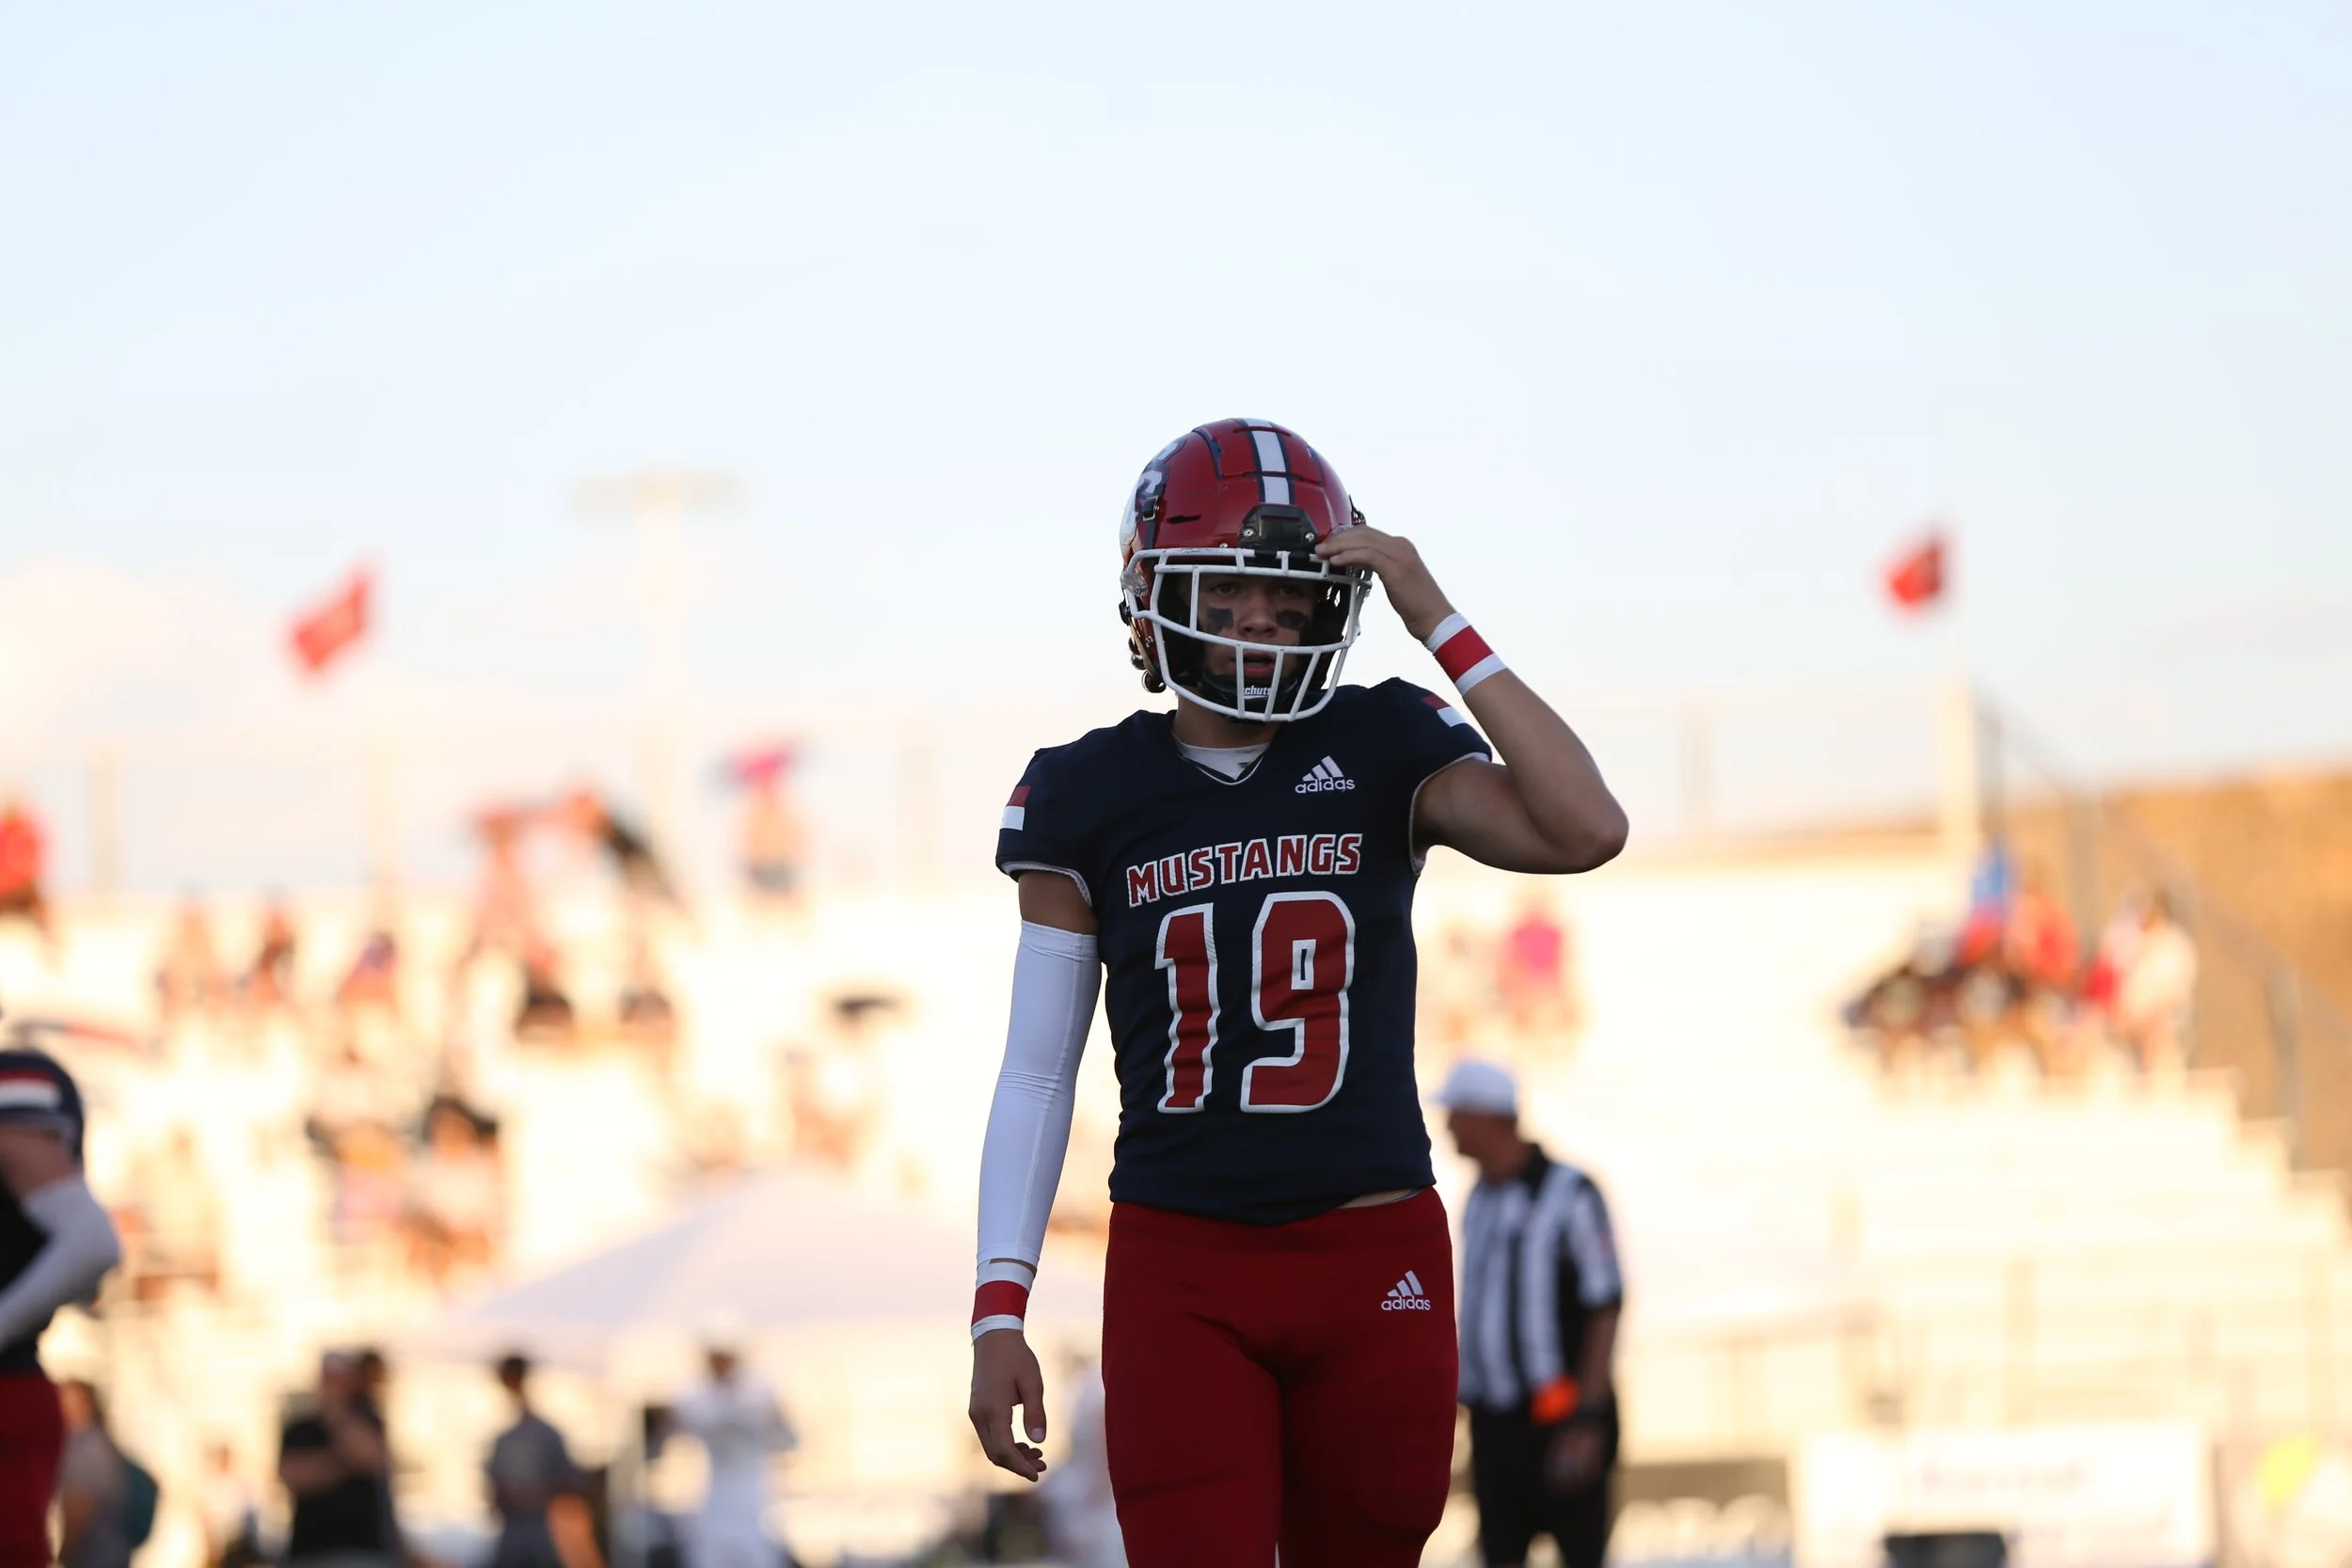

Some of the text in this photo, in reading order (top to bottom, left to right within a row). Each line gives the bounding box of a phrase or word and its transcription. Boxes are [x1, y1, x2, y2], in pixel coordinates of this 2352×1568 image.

[1295, 777, 1356, 794] adidas
[1127, 833, 1363, 908] MUSTANGS
[1155, 891, 1356, 1114] 19
[1380, 1295, 1431, 1311] adidas
